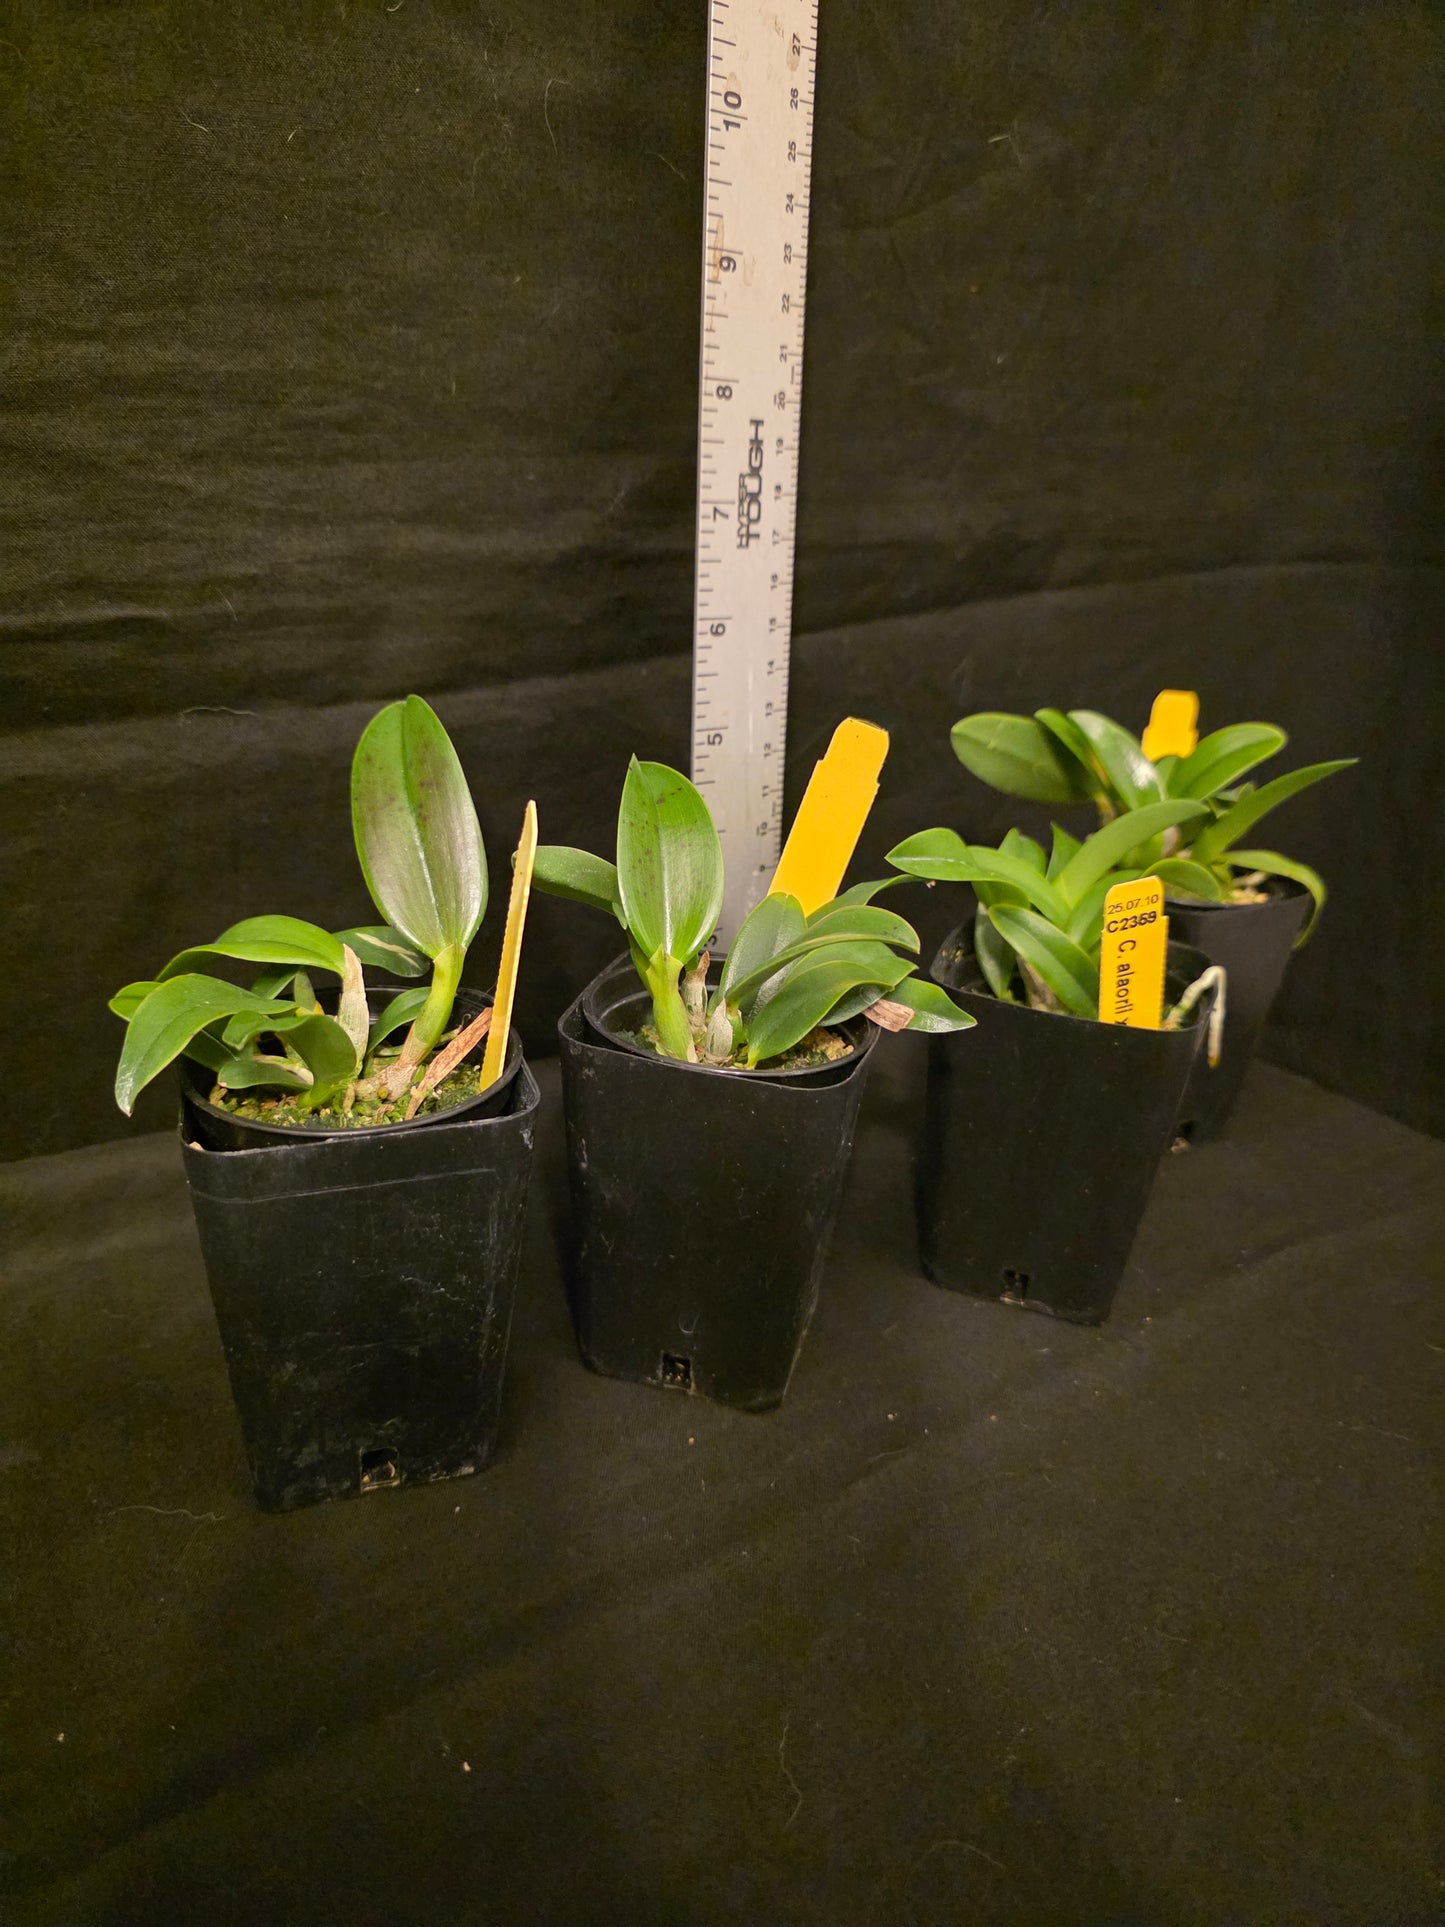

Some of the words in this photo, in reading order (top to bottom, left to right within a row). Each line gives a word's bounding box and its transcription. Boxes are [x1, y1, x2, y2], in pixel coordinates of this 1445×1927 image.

[792, 33, 801, 57] 27
[790, 88, 799, 110] 26
[723, 91, 742, 132] 10
[787, 141, 797, 163] 25
[785, 193, 794, 214] 24
[783, 243, 792, 265] 23
[719, 256, 737, 273] 9
[781, 294, 790, 314] 22
[779, 345, 787, 363] 21
[716, 385, 733, 400] 8
[777, 391, 786, 410] 20
[775, 438, 784, 456] 19
[747, 419, 764, 549] TOUGH
[713, 506, 729, 522] 7
[772, 529, 780, 546] 17
[770, 573, 778, 591] 16
[710, 623, 726, 637] 6
[769, 617, 777, 633] 15
[767, 660, 774, 676] 14
[765, 702, 773, 717] 13
[707, 733, 723, 746] 5
[763, 743, 771, 758] 12
[762, 785, 769, 797] 11
[760, 822, 768, 836] 10
